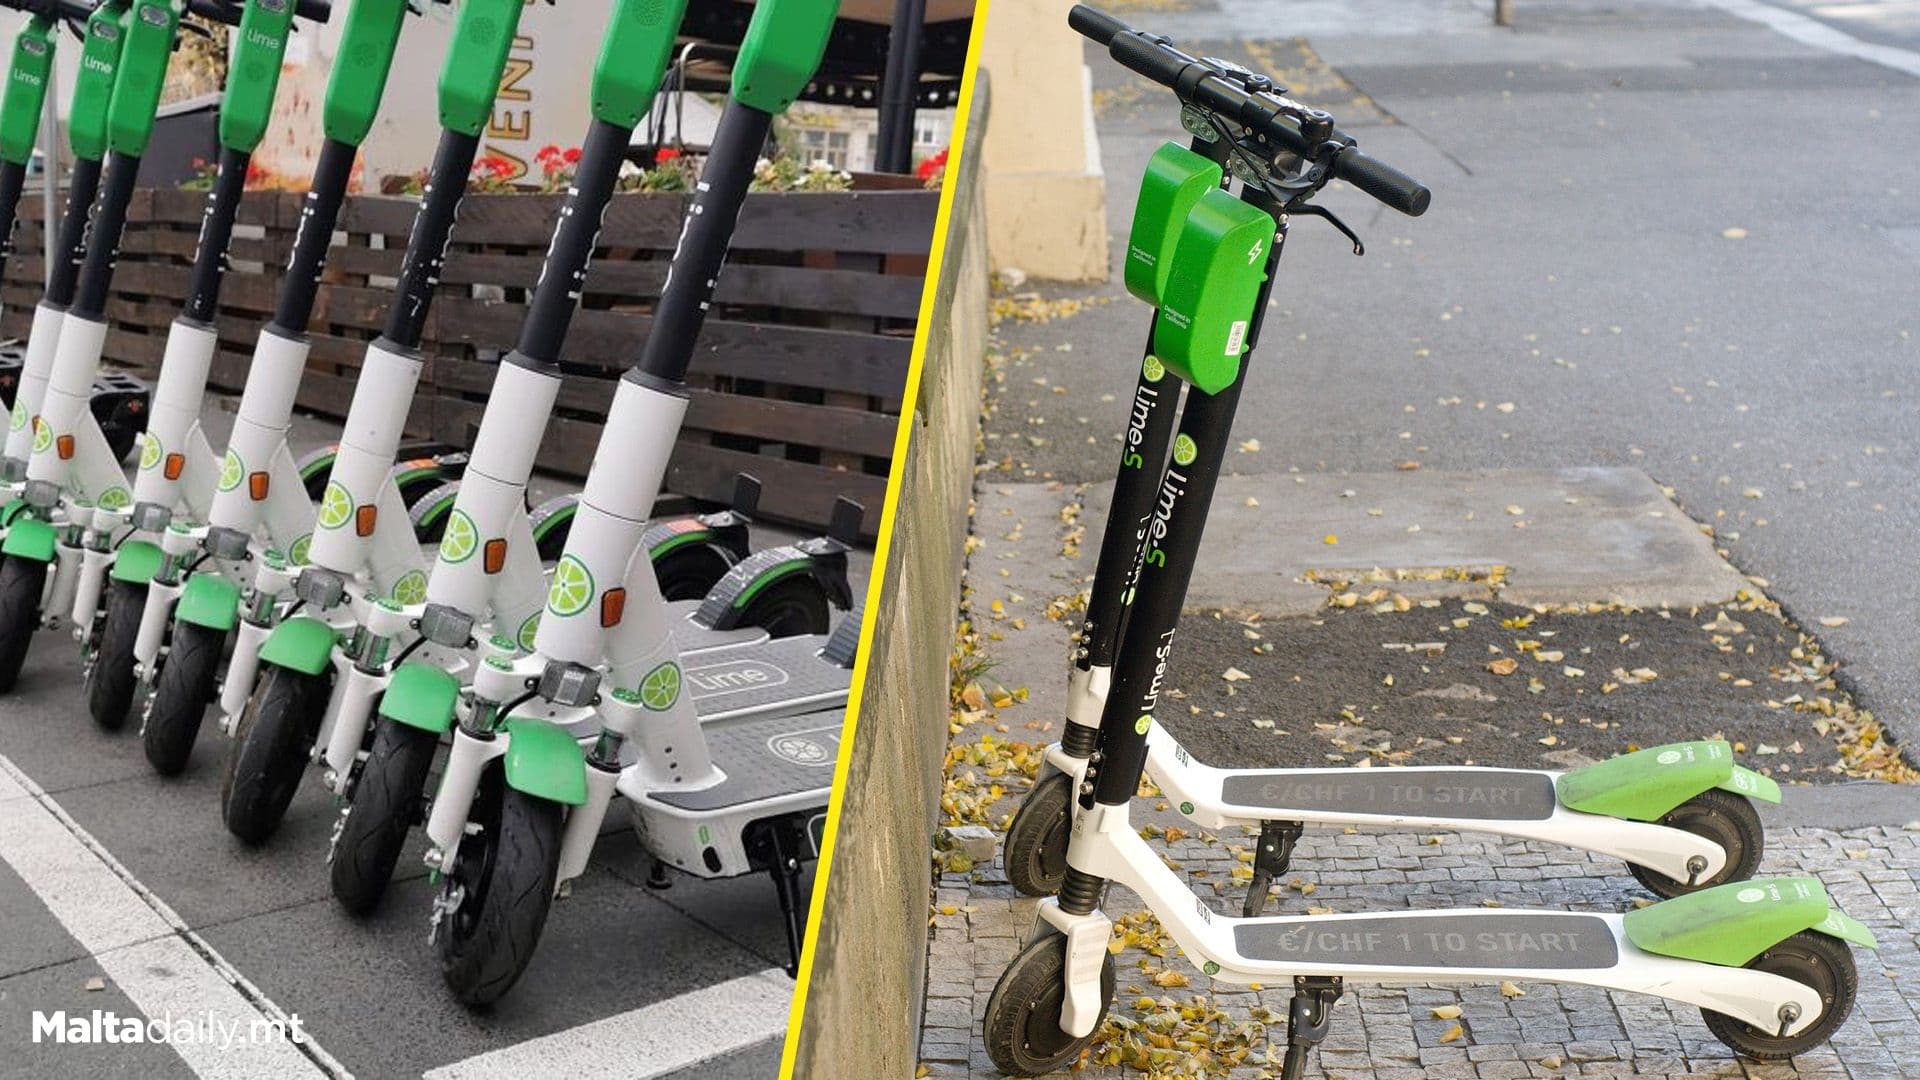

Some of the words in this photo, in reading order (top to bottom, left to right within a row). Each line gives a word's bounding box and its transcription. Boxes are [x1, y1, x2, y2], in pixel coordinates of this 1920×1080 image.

[247, 27, 280, 49] Lime
[84, 55, 113, 75] Lime
[14, 69, 41, 86] Lime
[686, 669, 768, 690] Lime
[1366, 785, 1376, 801] 1
[1388, 785, 1424, 802] TO
[1433, 785, 1525, 804] START
[1396, 933, 1411, 952] 1
[1423, 932, 1467, 952] TO
[1477, 932, 1580, 952] START
